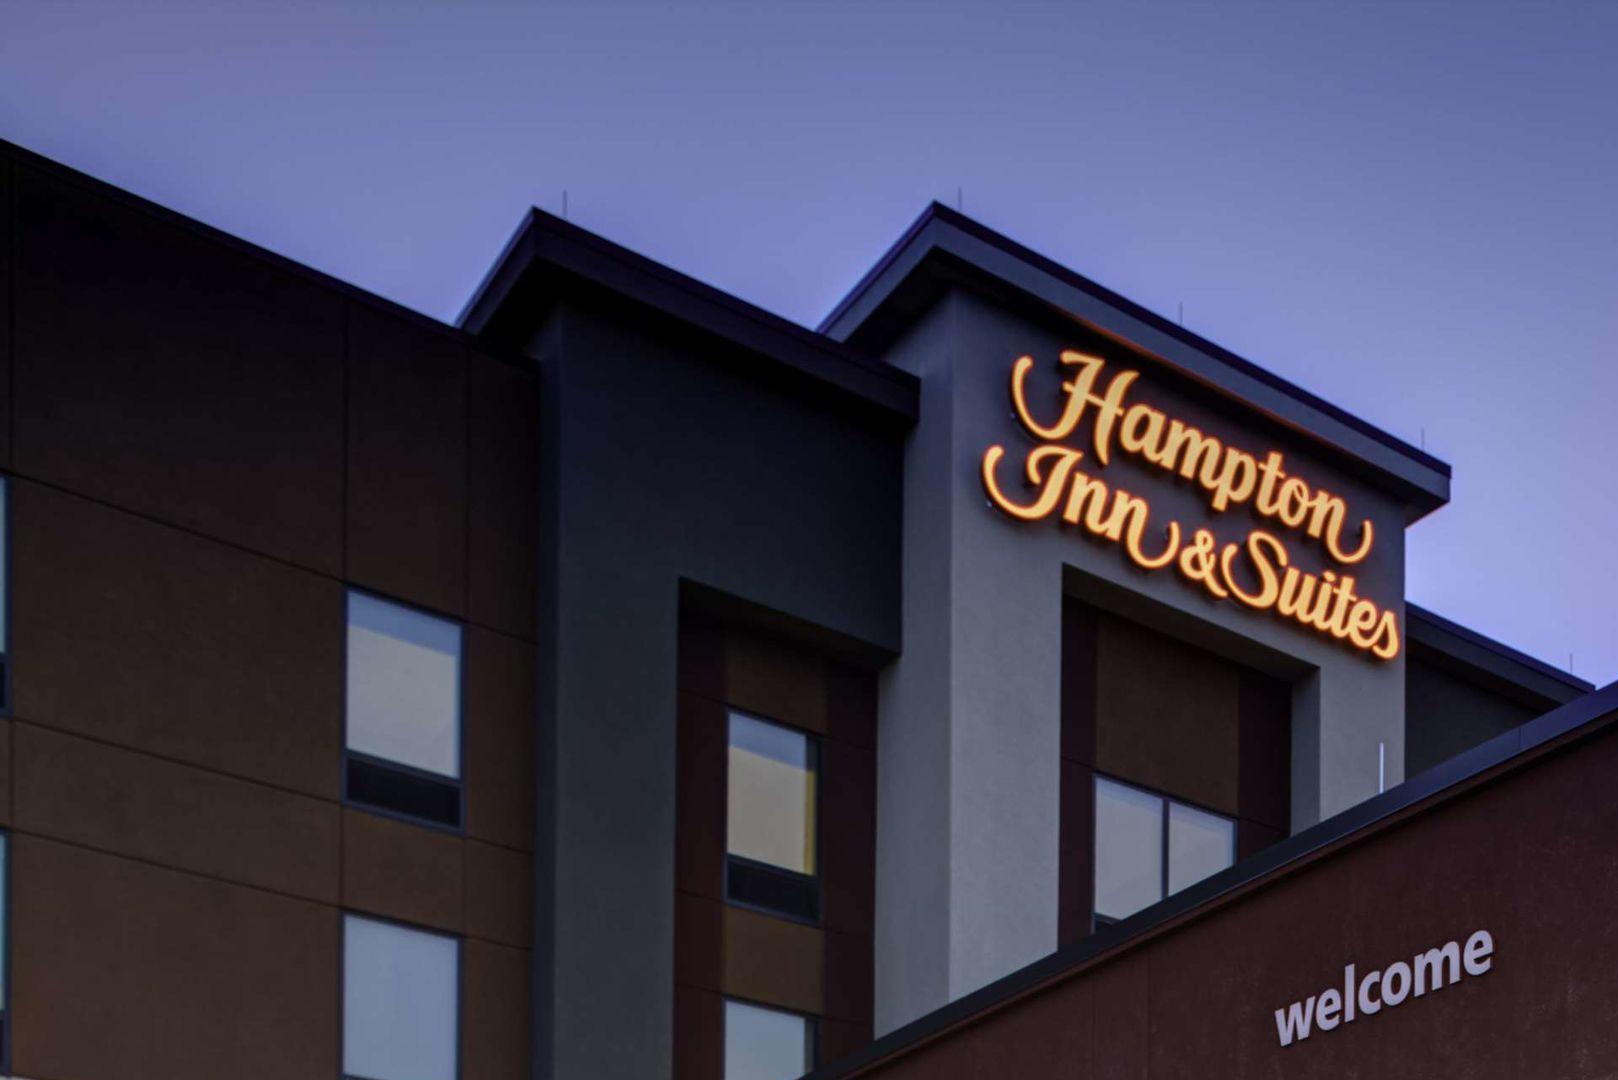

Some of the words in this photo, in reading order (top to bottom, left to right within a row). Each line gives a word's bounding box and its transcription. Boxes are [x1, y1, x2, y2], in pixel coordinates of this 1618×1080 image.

[981, 444, 1180, 569] Inn
[1179, 529, 1229, 598] &
[1221, 530, 1400, 661] Suites
[1011, 349, 1374, 564] Hampton
[1274, 929, 1494, 1047] welcome
